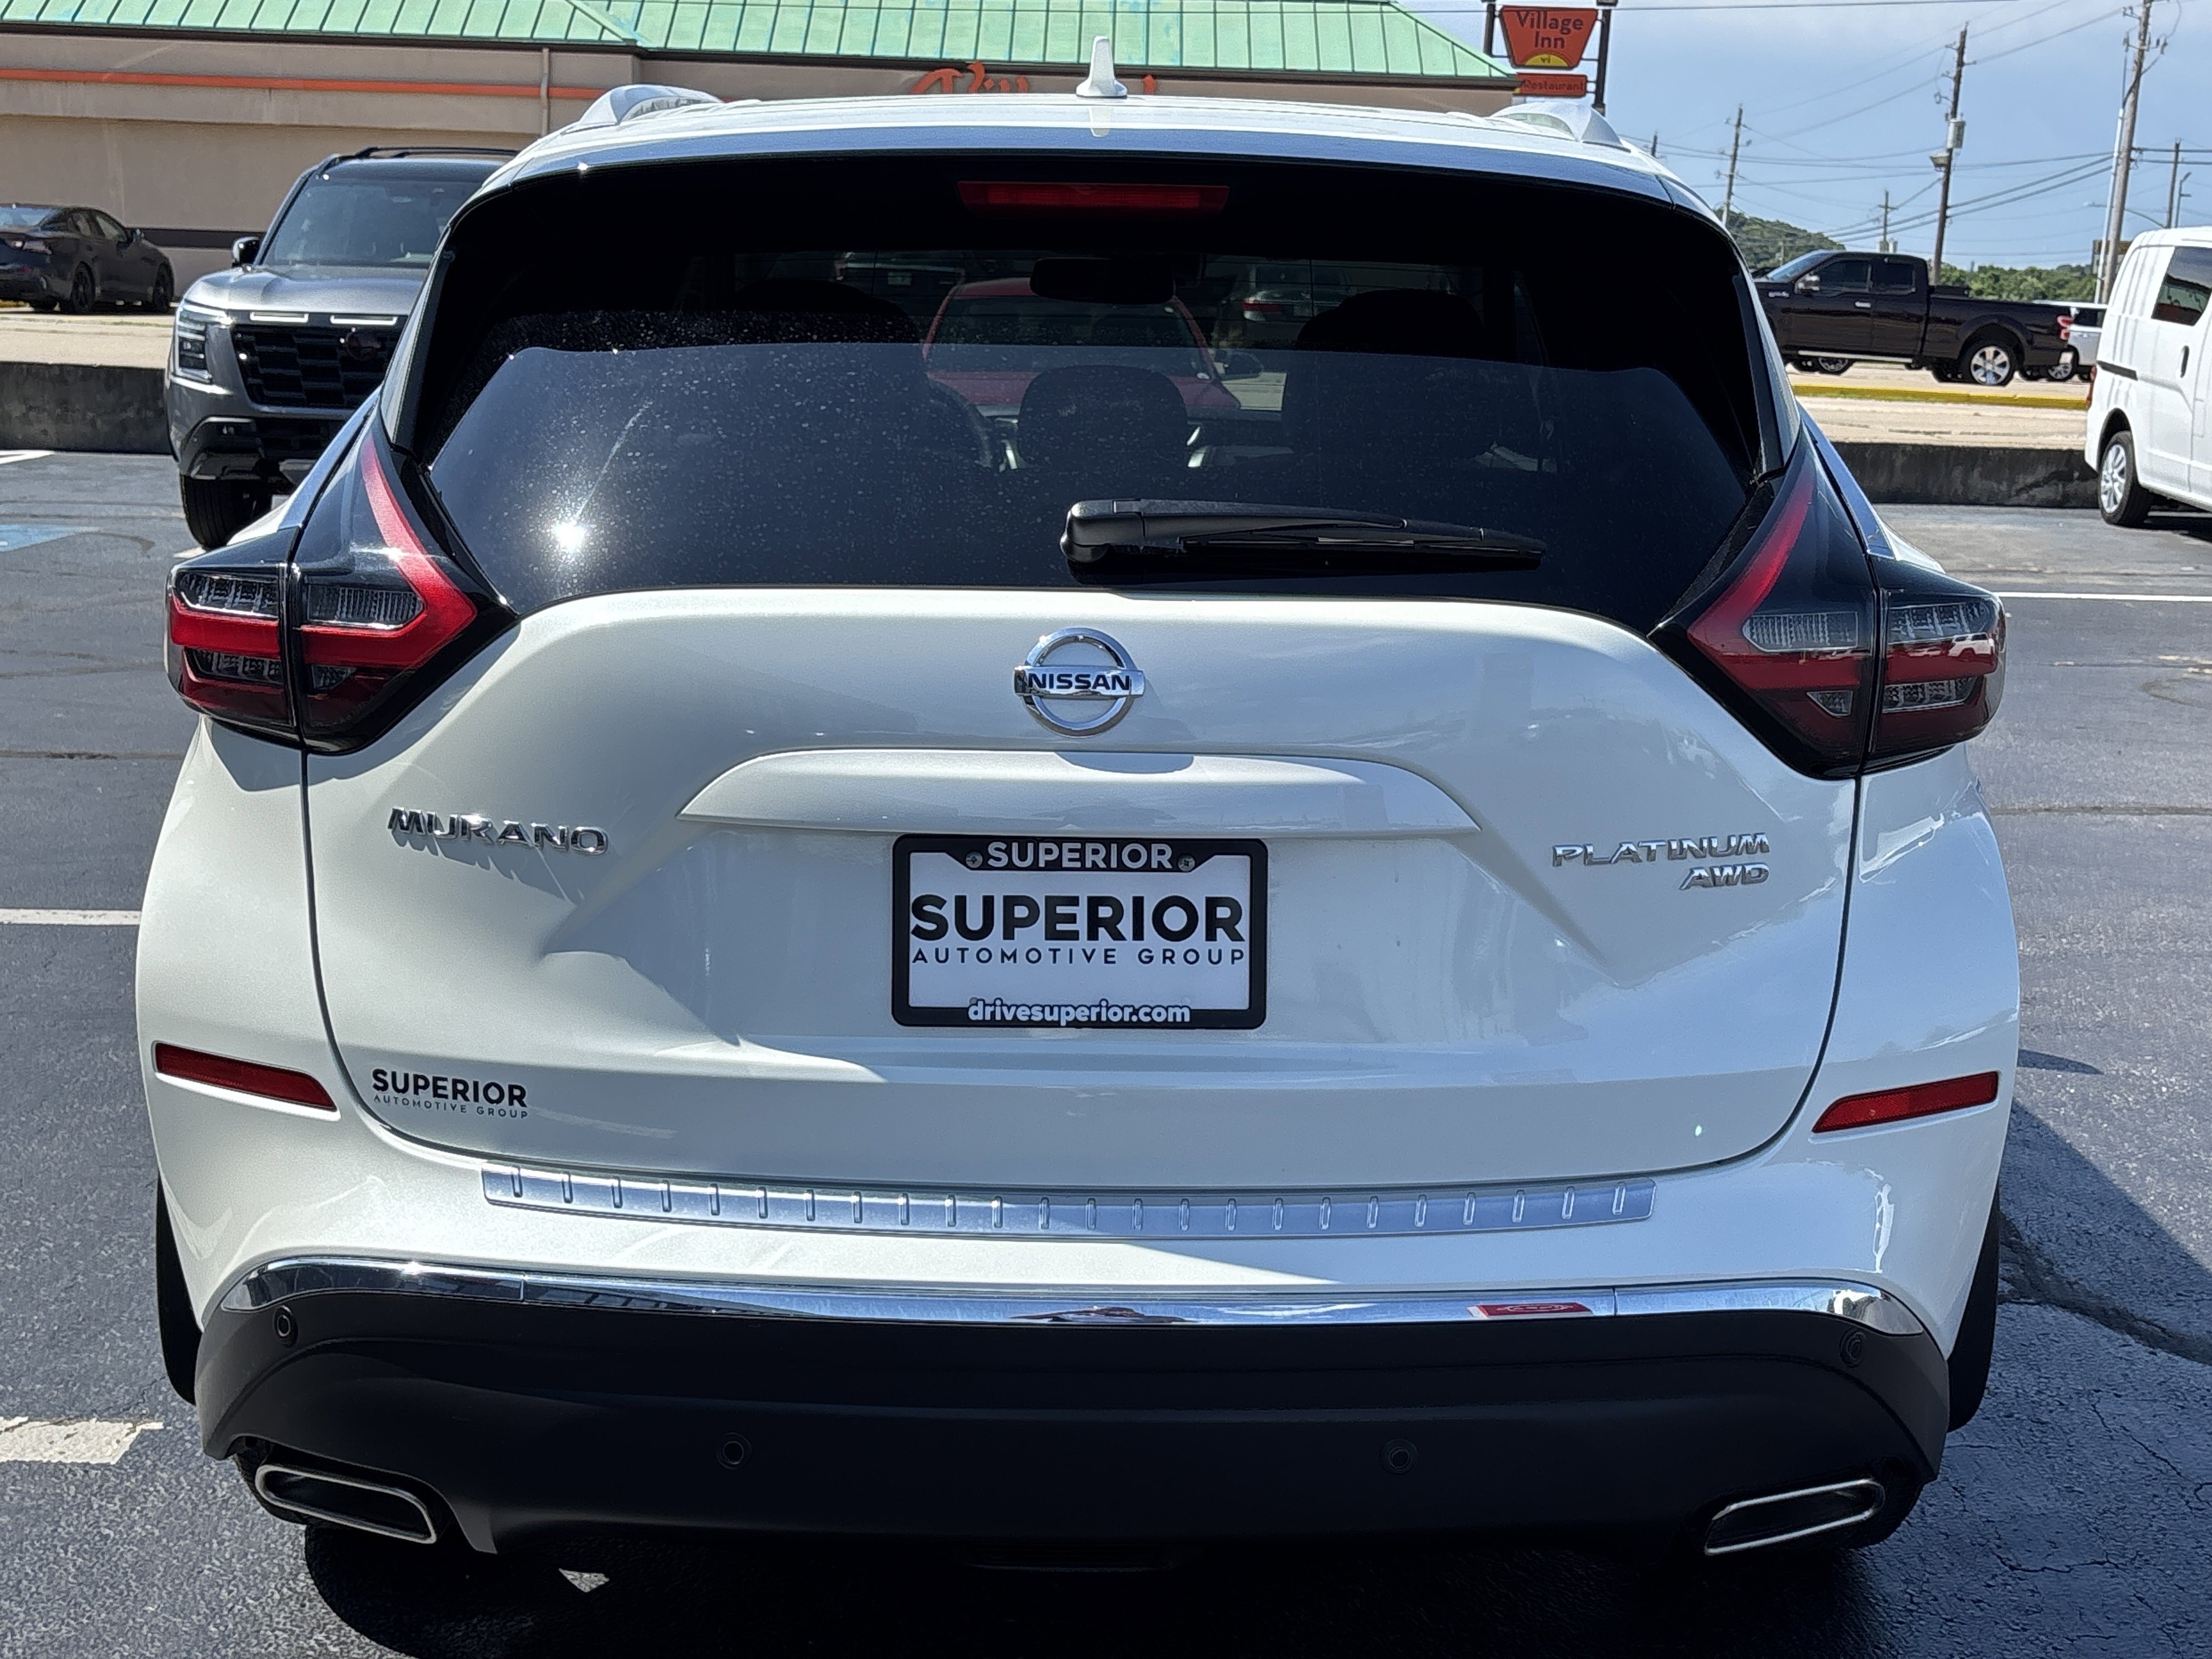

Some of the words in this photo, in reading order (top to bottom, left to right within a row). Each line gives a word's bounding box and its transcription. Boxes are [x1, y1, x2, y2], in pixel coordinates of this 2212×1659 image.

[1516, 10, 1584, 35] Village
[1534, 31, 1565, 49] Inn
[1524, 79, 1584, 91] Restaurant
[1028, 673, 1130, 690] NISSAN
[388, 805, 609, 855] MURANO
[987, 842, 1173, 869] SUPERIOR
[1552, 832, 1770, 867] PLATINUM
[1678, 862, 1770, 890] AWD
[911, 894, 1245, 942] SUPERIOR
[912, 947, 1116, 964] AUTOMOTIVE
[1137, 948, 1244, 965] GROUP
[968, 998, 1190, 1026] drivesuperior.com
[372, 1068, 528, 1108] SUPERIOR
[374, 1094, 467, 1114] AUTOMOTIVE
[476, 1106, 528, 1119] GROUP
